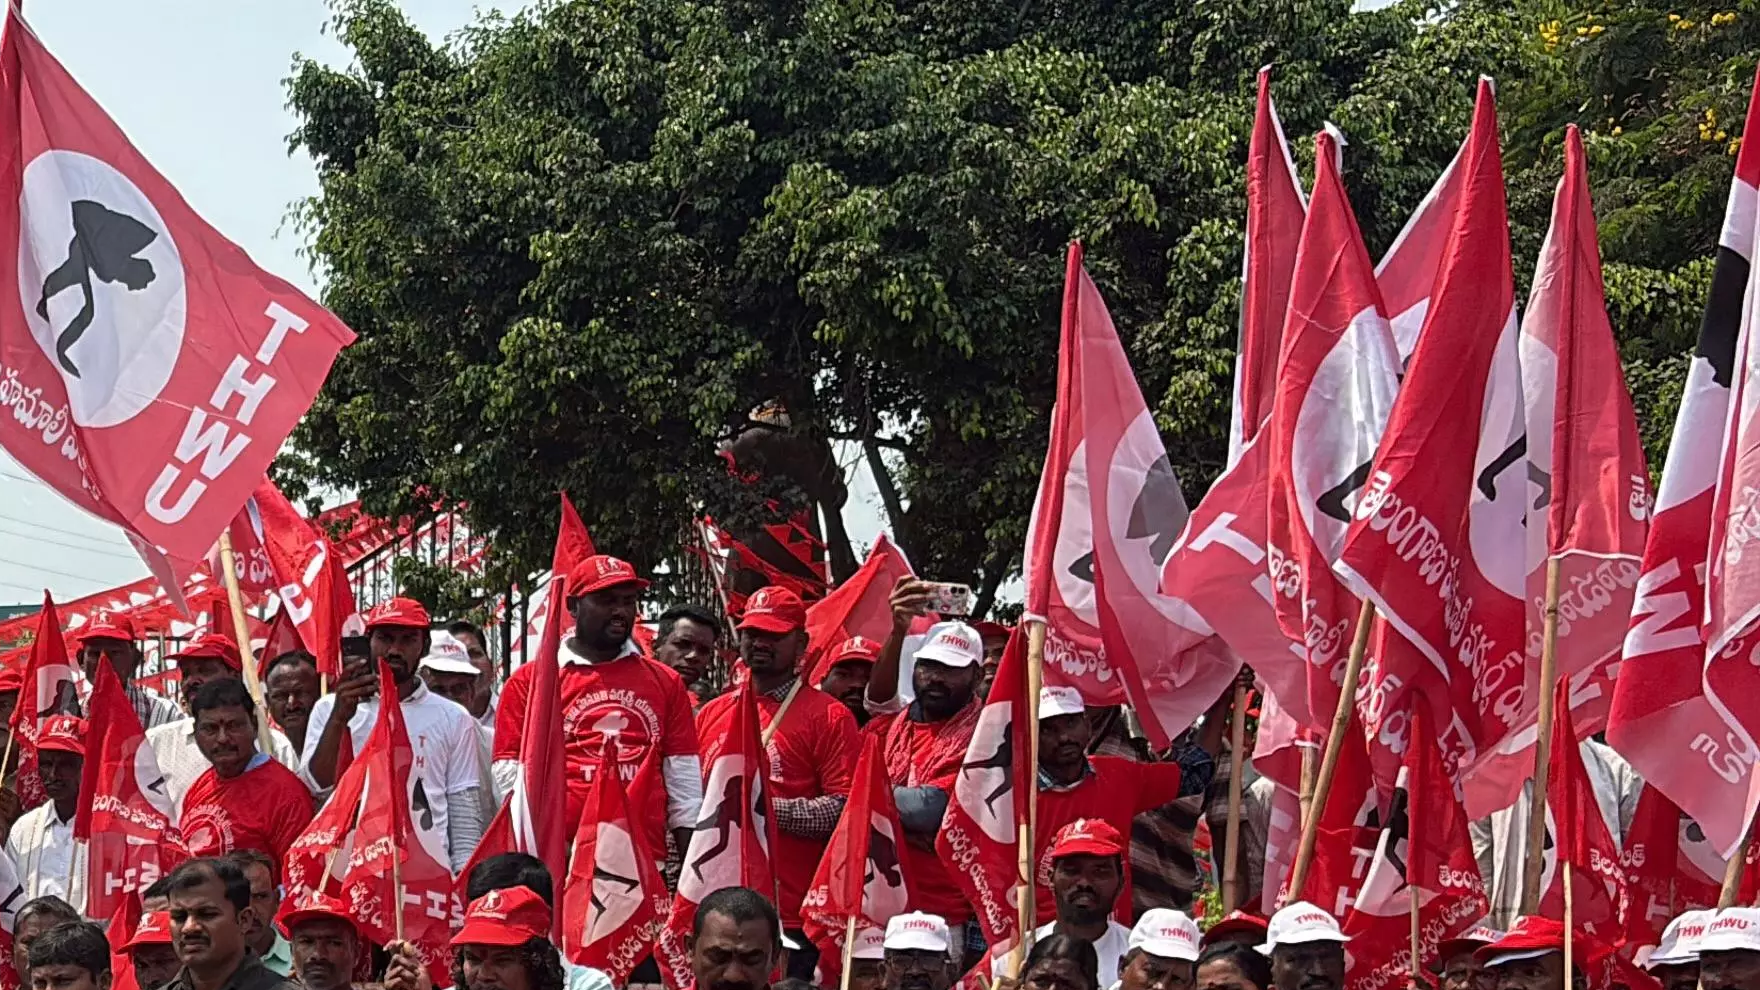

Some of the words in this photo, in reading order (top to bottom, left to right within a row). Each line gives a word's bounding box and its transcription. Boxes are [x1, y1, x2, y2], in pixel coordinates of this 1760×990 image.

[144, 300, 311, 524] THWU
[939, 634, 971, 652] THWU
[1159, 927, 1193, 942] THWU
[1676, 925, 1705, 937] THW
